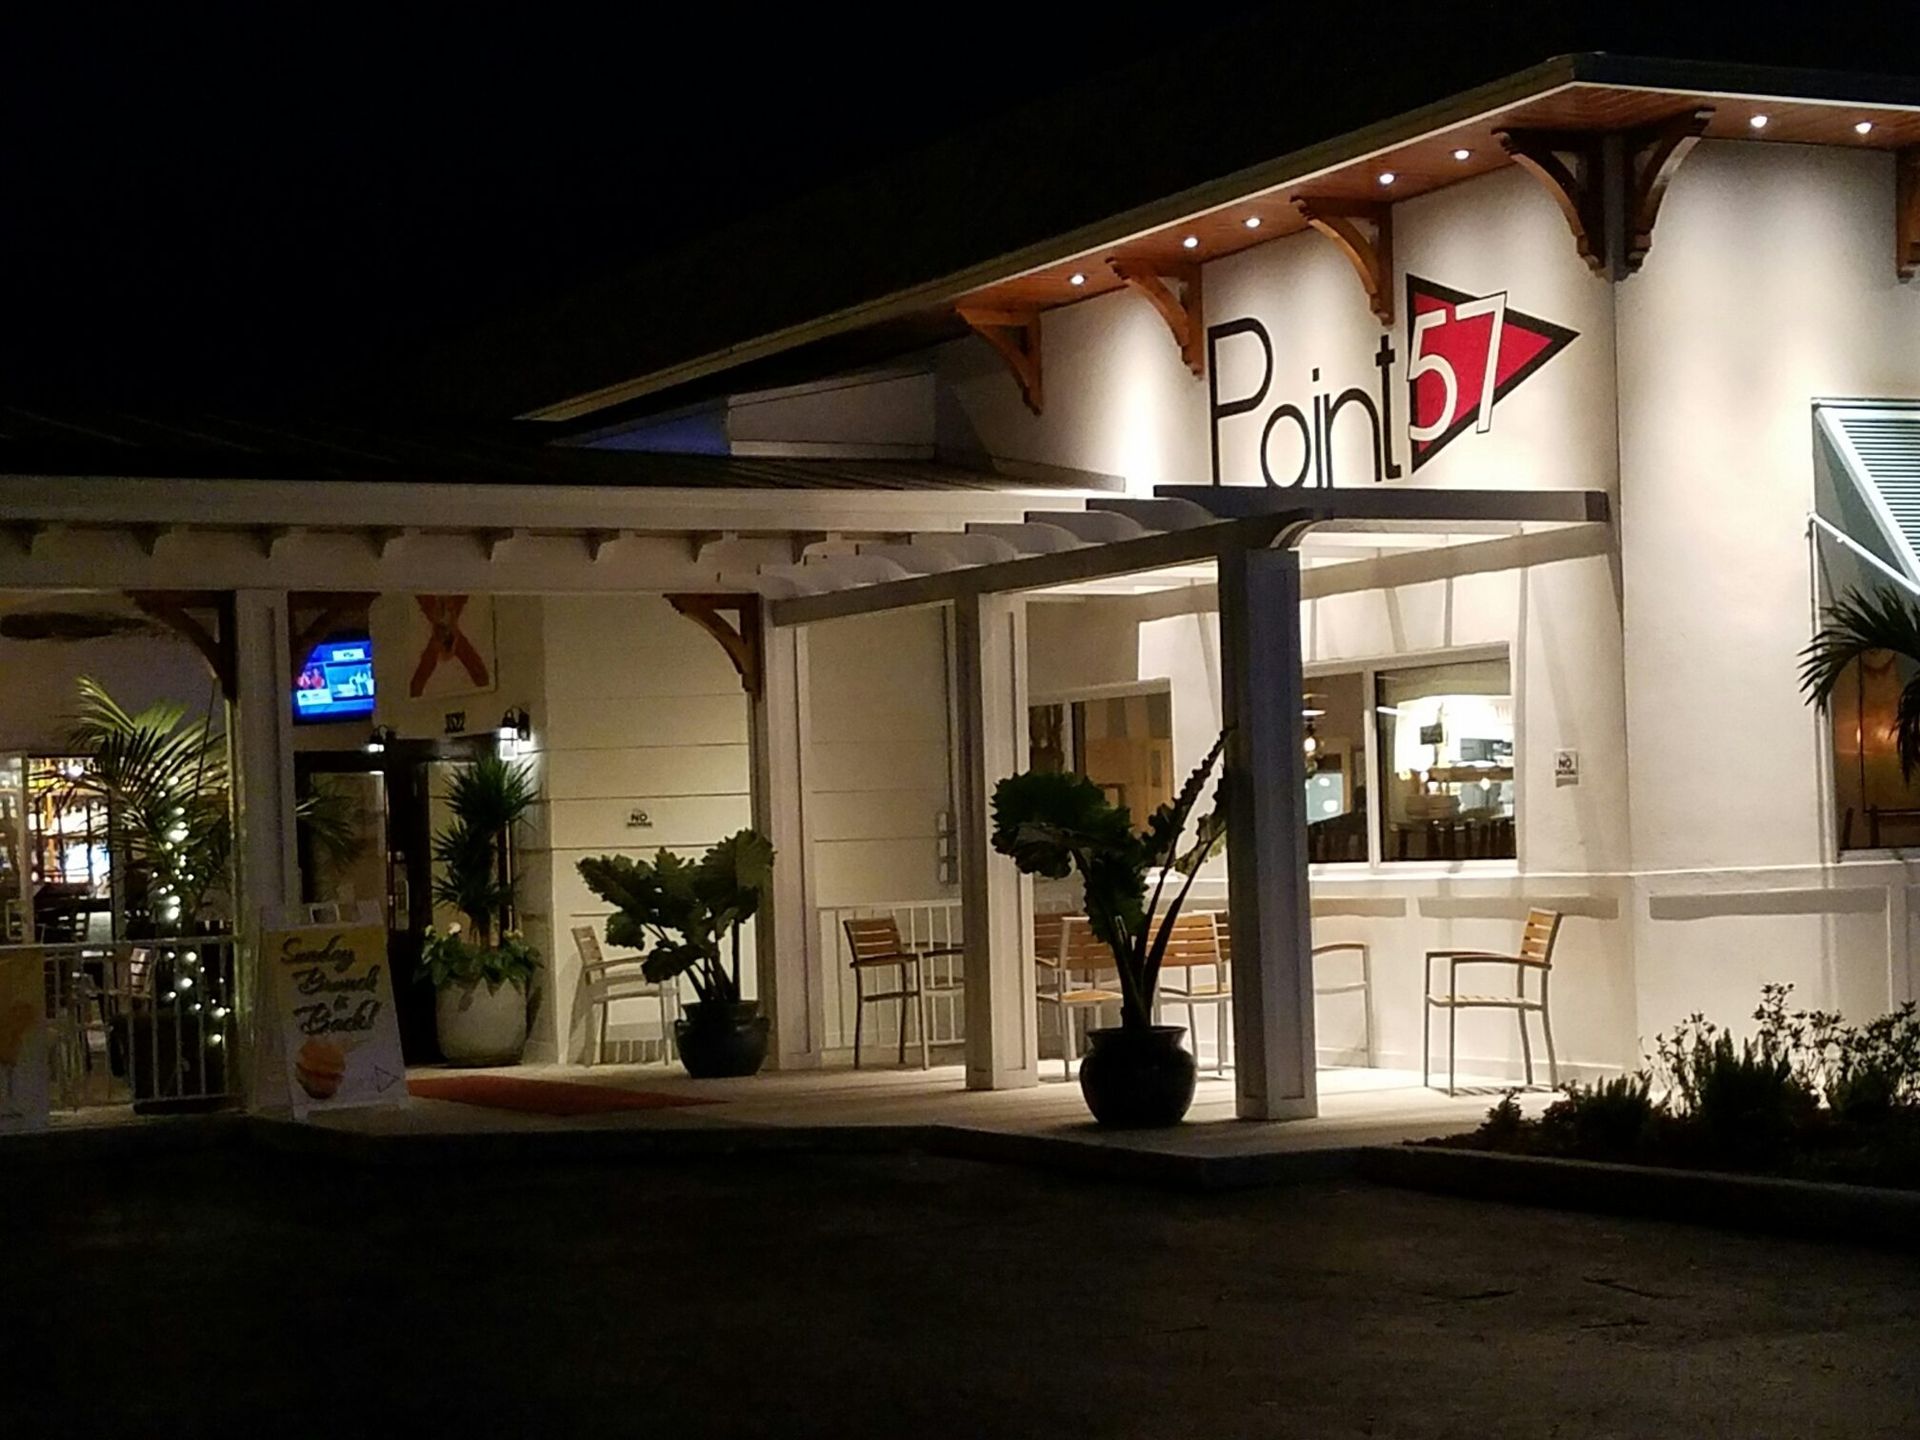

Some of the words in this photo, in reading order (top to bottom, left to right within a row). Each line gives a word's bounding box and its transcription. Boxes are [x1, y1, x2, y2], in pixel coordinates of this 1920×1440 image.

[1207, 317, 1402, 488] Point
[1407, 290, 1508, 442] 57
[1558, 758, 1572, 769] NO
[631, 813, 648, 822] NO
[280, 934, 355, 972] Sunday
